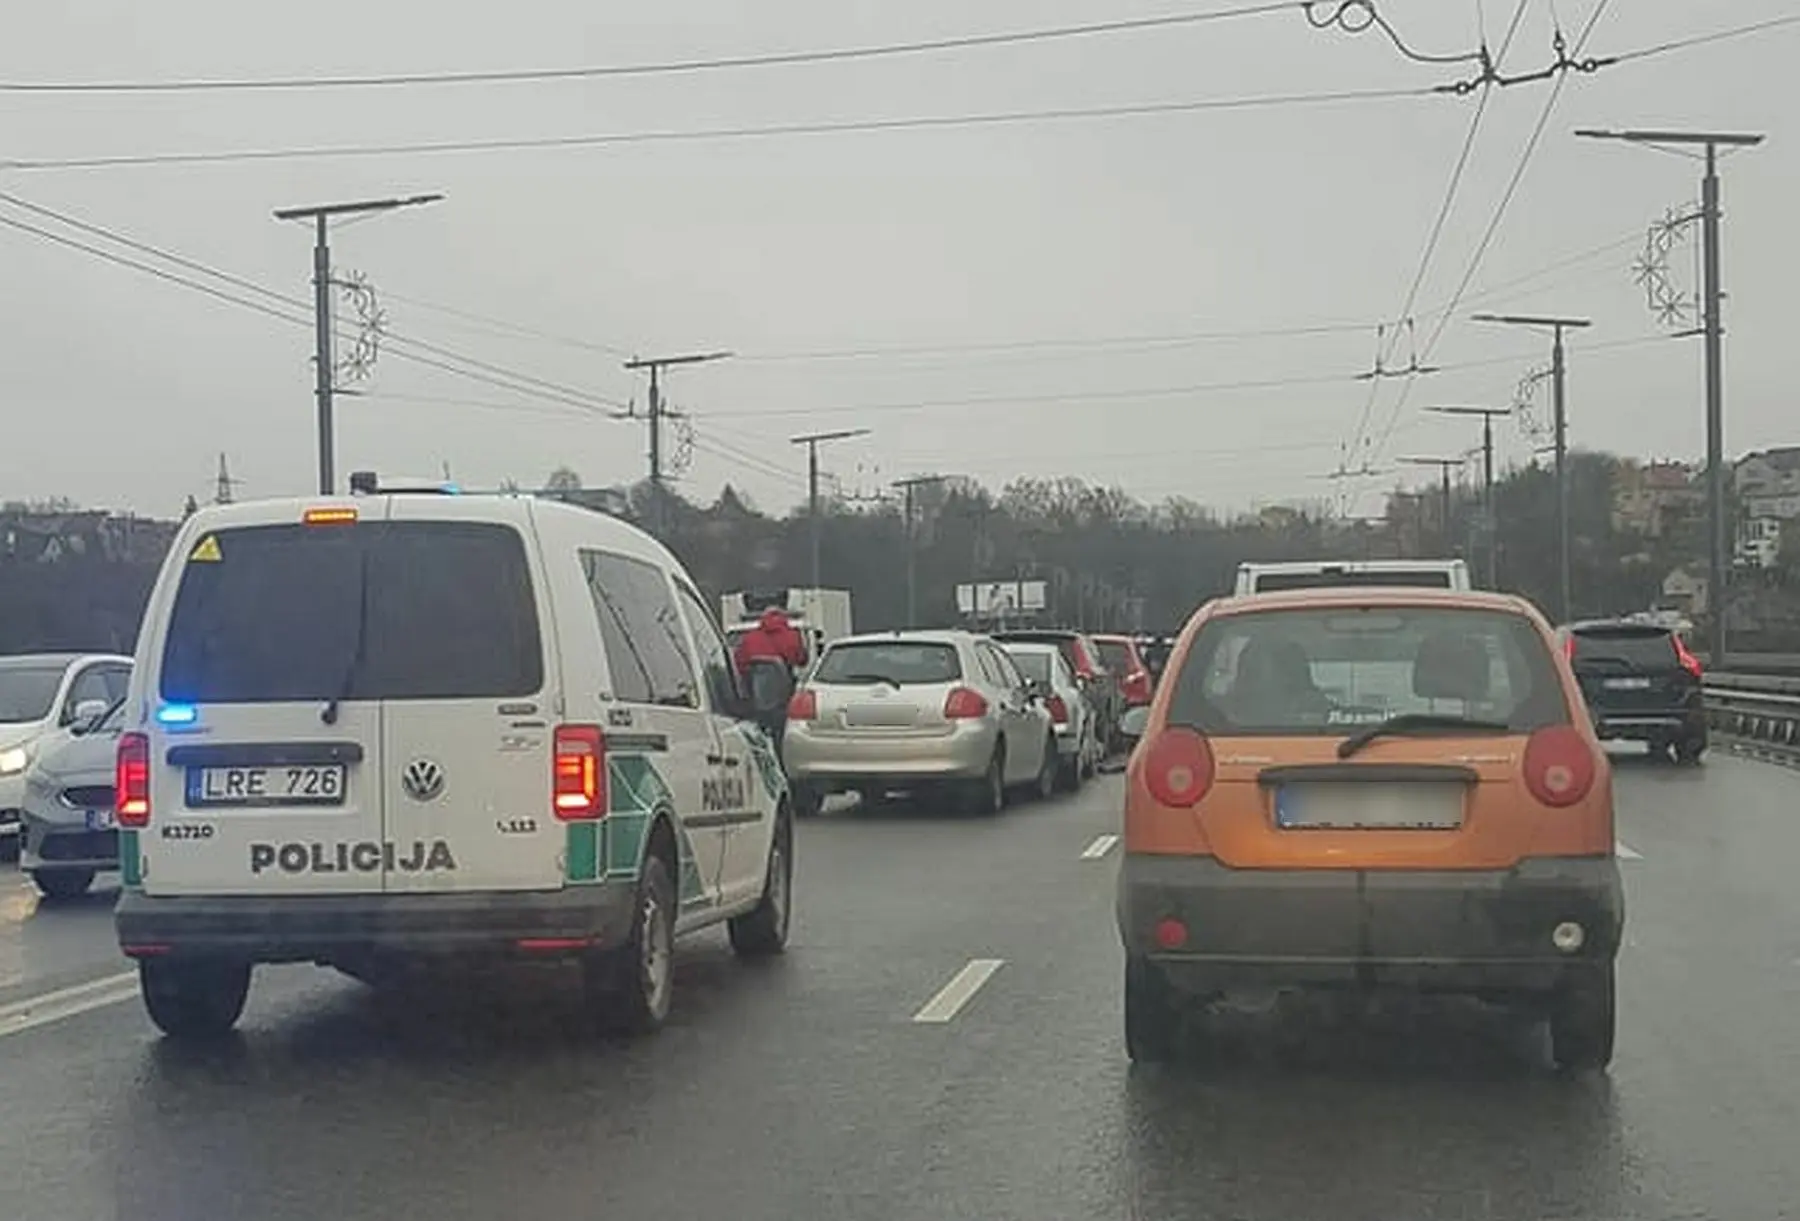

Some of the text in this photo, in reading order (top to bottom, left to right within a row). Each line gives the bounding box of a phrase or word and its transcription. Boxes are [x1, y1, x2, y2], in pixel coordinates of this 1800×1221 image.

[206, 770, 267, 796] LRE
[287, 769, 338, 794] 726
[251, 841, 456, 873] POLICIJA
